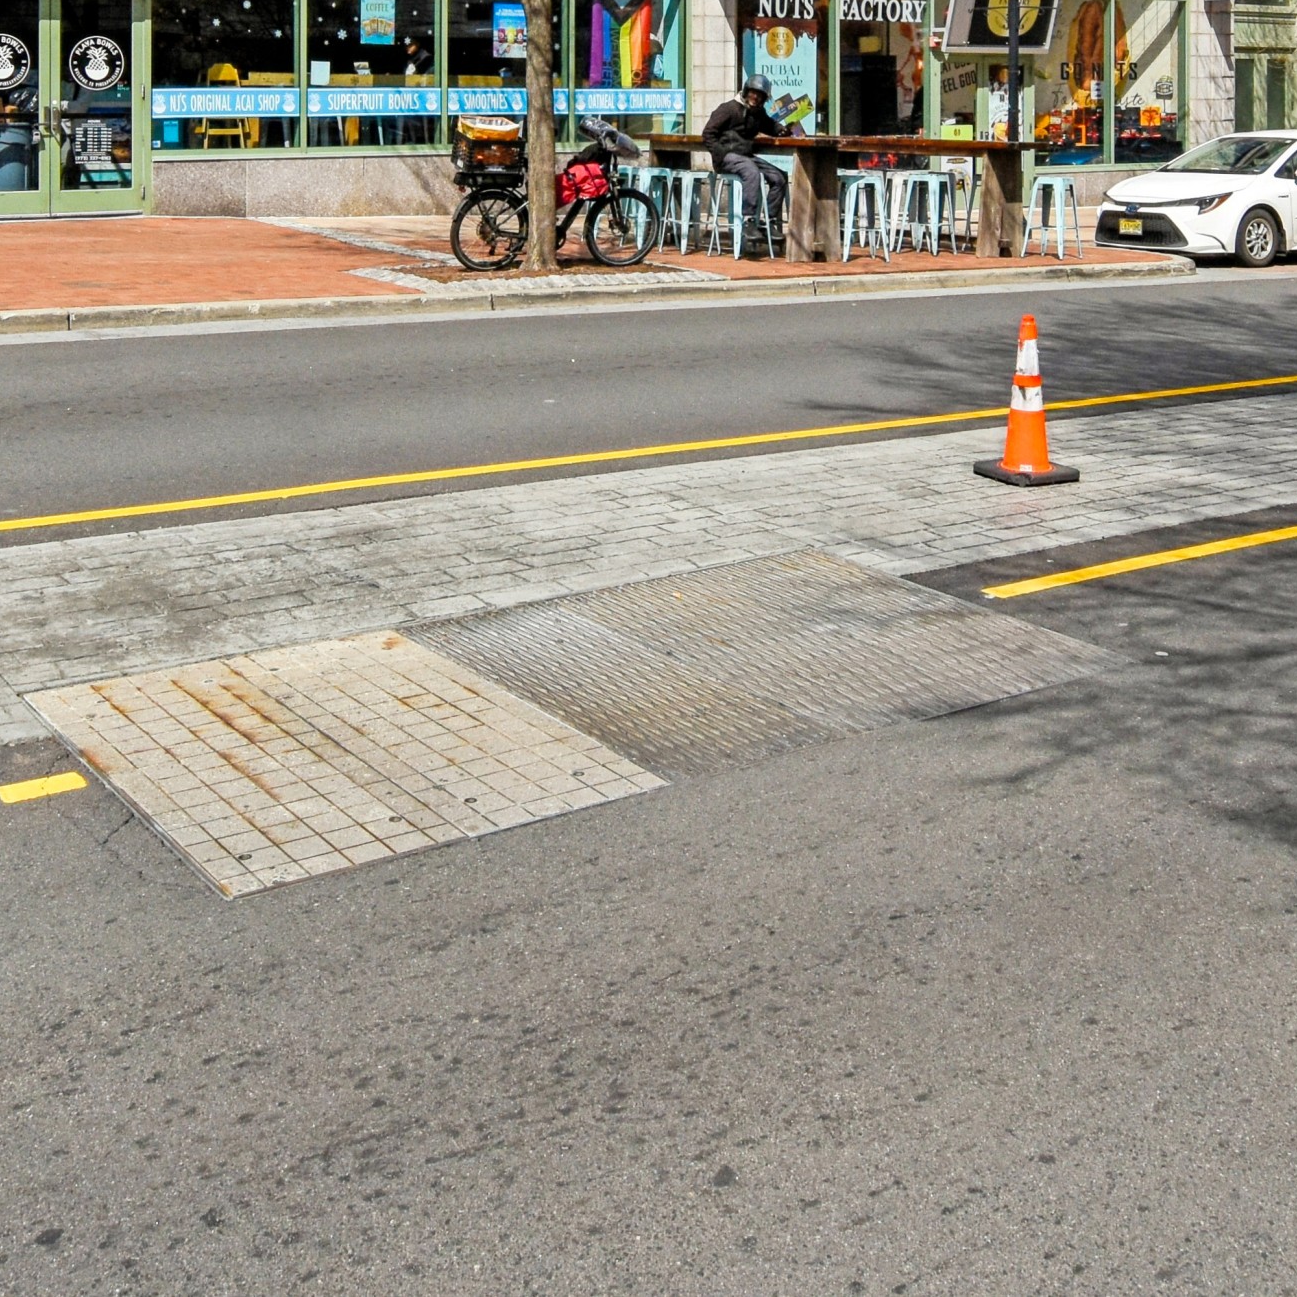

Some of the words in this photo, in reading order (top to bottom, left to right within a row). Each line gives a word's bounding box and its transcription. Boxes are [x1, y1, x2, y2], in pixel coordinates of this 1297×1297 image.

[365, 3, 389, 12] COFFEE
[0, 36, 24, 54] BOWLS
[75, 39, 95, 56] PLAYA
[96, 38, 118, 56] BOWLS
[761, 63, 802, 76] DUBAI
[1060, 62, 1082, 80] GO
[1091, 62, 1138, 80] NTS
[770, 75, 803, 87] ocolate
[169, 93, 187, 112] NJ'S
[190, 94, 231, 112] ORIGINAL
[234, 94, 255, 111] ACAI
[257, 93, 281, 111] SHOP
[327, 93, 384, 111] SUPERFRUIT
[388, 93, 420, 110] BOWLS
[463, 93, 508, 109] SMOOTHIES
[587, 93, 615, 109] OATMEAL
[629, 93, 644, 109] CHIA
[644, 93, 672, 109] PUDDING
